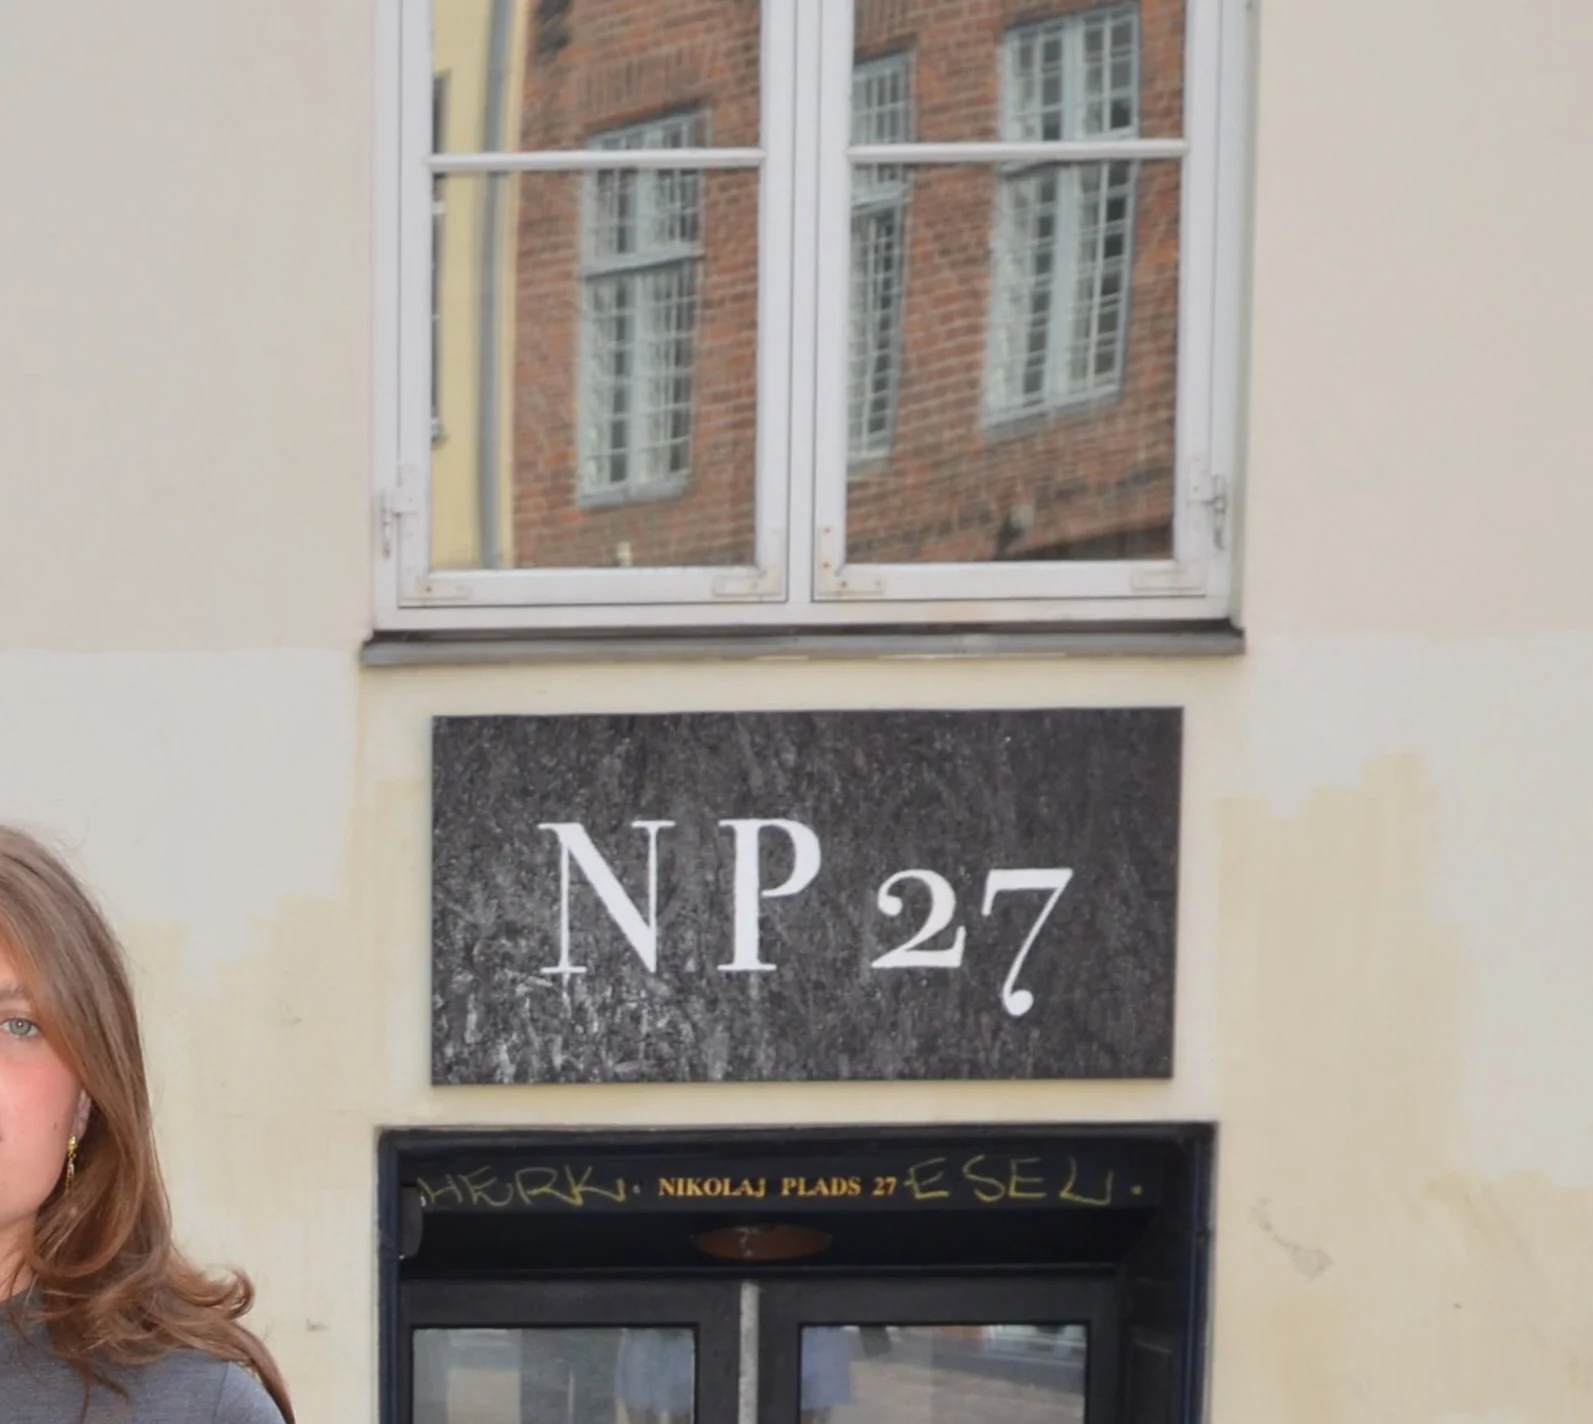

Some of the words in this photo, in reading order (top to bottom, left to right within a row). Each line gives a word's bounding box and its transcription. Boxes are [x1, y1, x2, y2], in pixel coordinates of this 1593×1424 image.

[870, 867, 1074, 1016] 27
[658, 1177, 767, 1198] NIKOLAJ
[781, 1177, 862, 1197] PLADS
[871, 1176, 898, 1197] 27
